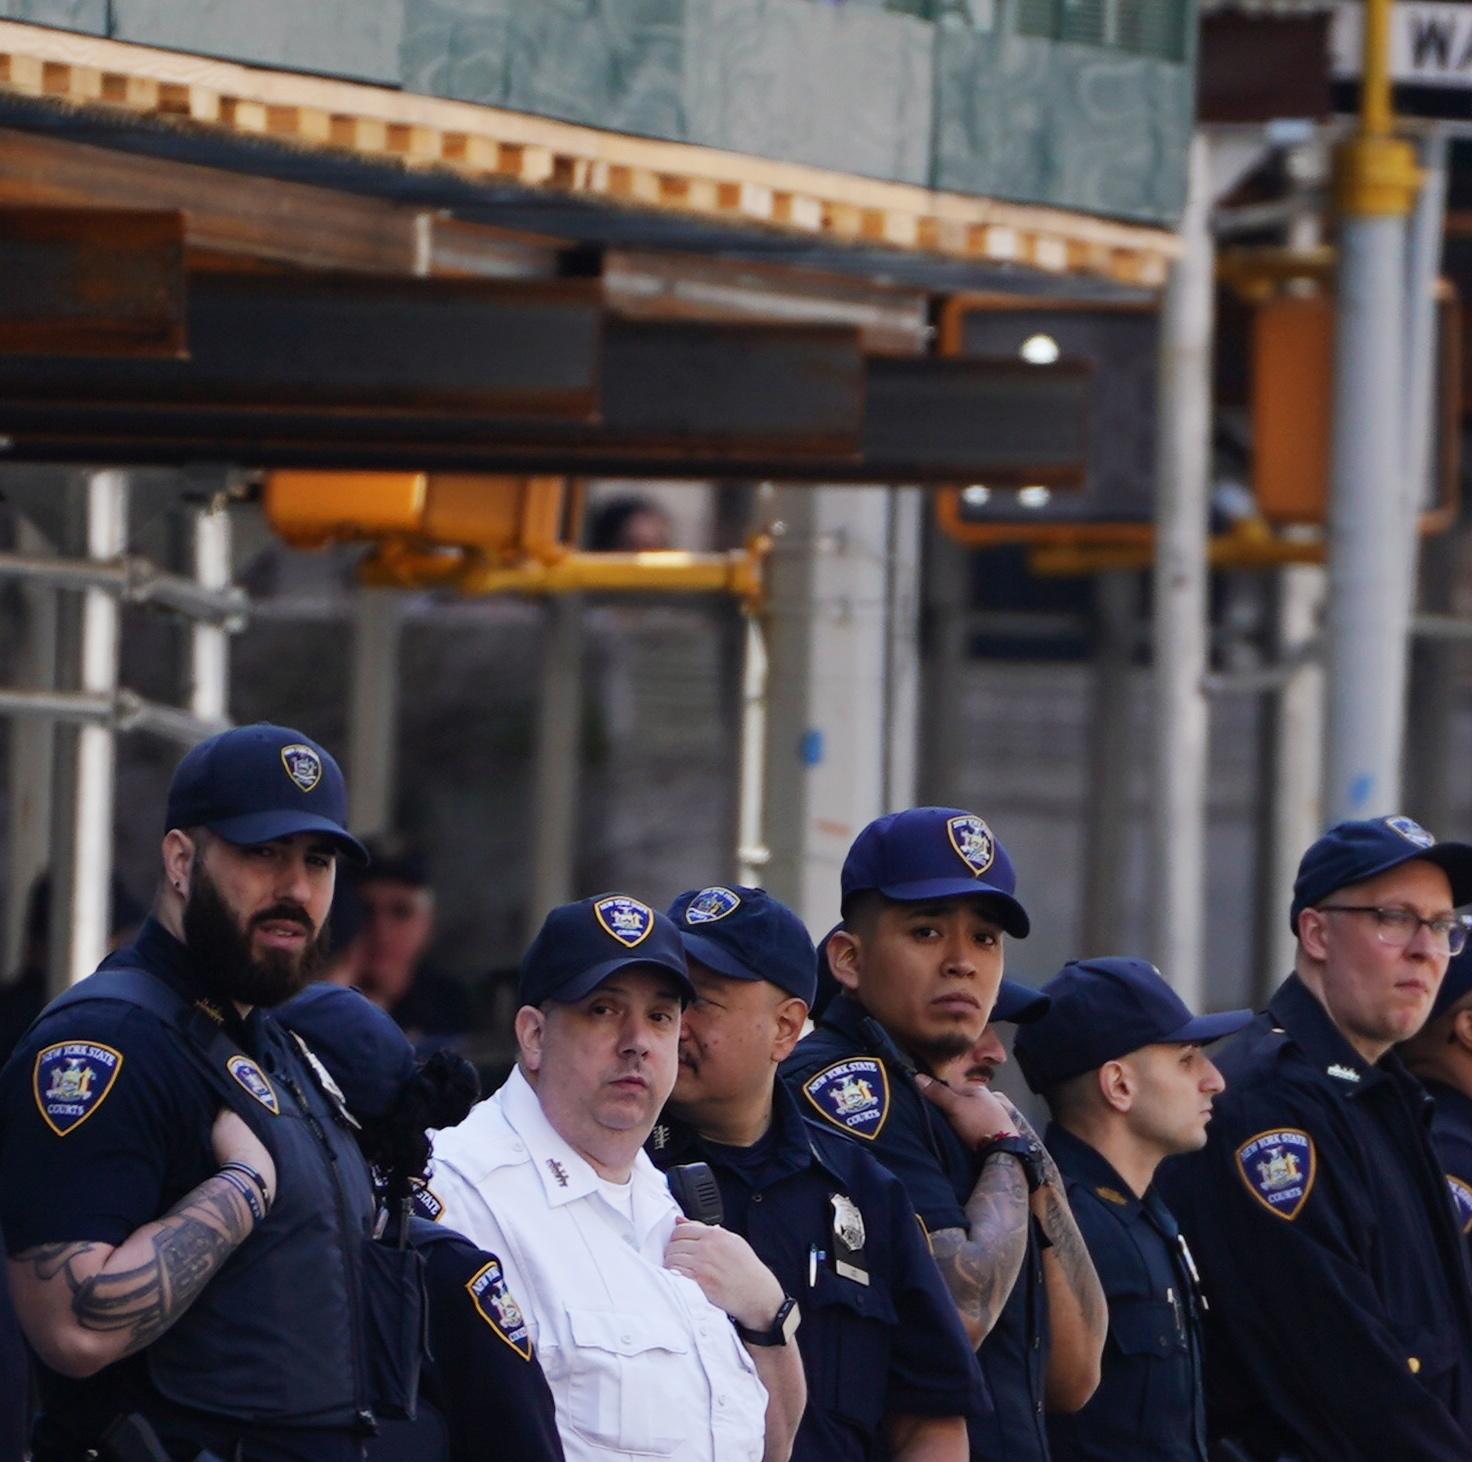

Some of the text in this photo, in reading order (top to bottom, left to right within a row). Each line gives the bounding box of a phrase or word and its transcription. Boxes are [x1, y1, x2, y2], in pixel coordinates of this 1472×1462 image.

[40, 1044, 117, 1067] NEW YORK STATE
[808, 1061, 878, 1094] NEW YORK STATE
[47, 1103, 85, 1116] COURTS
[846, 1108, 882, 1127] COURTS
[1240, 1132, 1309, 1162] NEW YORK STATE
[415, 1190, 442, 1216] STATE
[1268, 1186, 1304, 1204] COURTS
